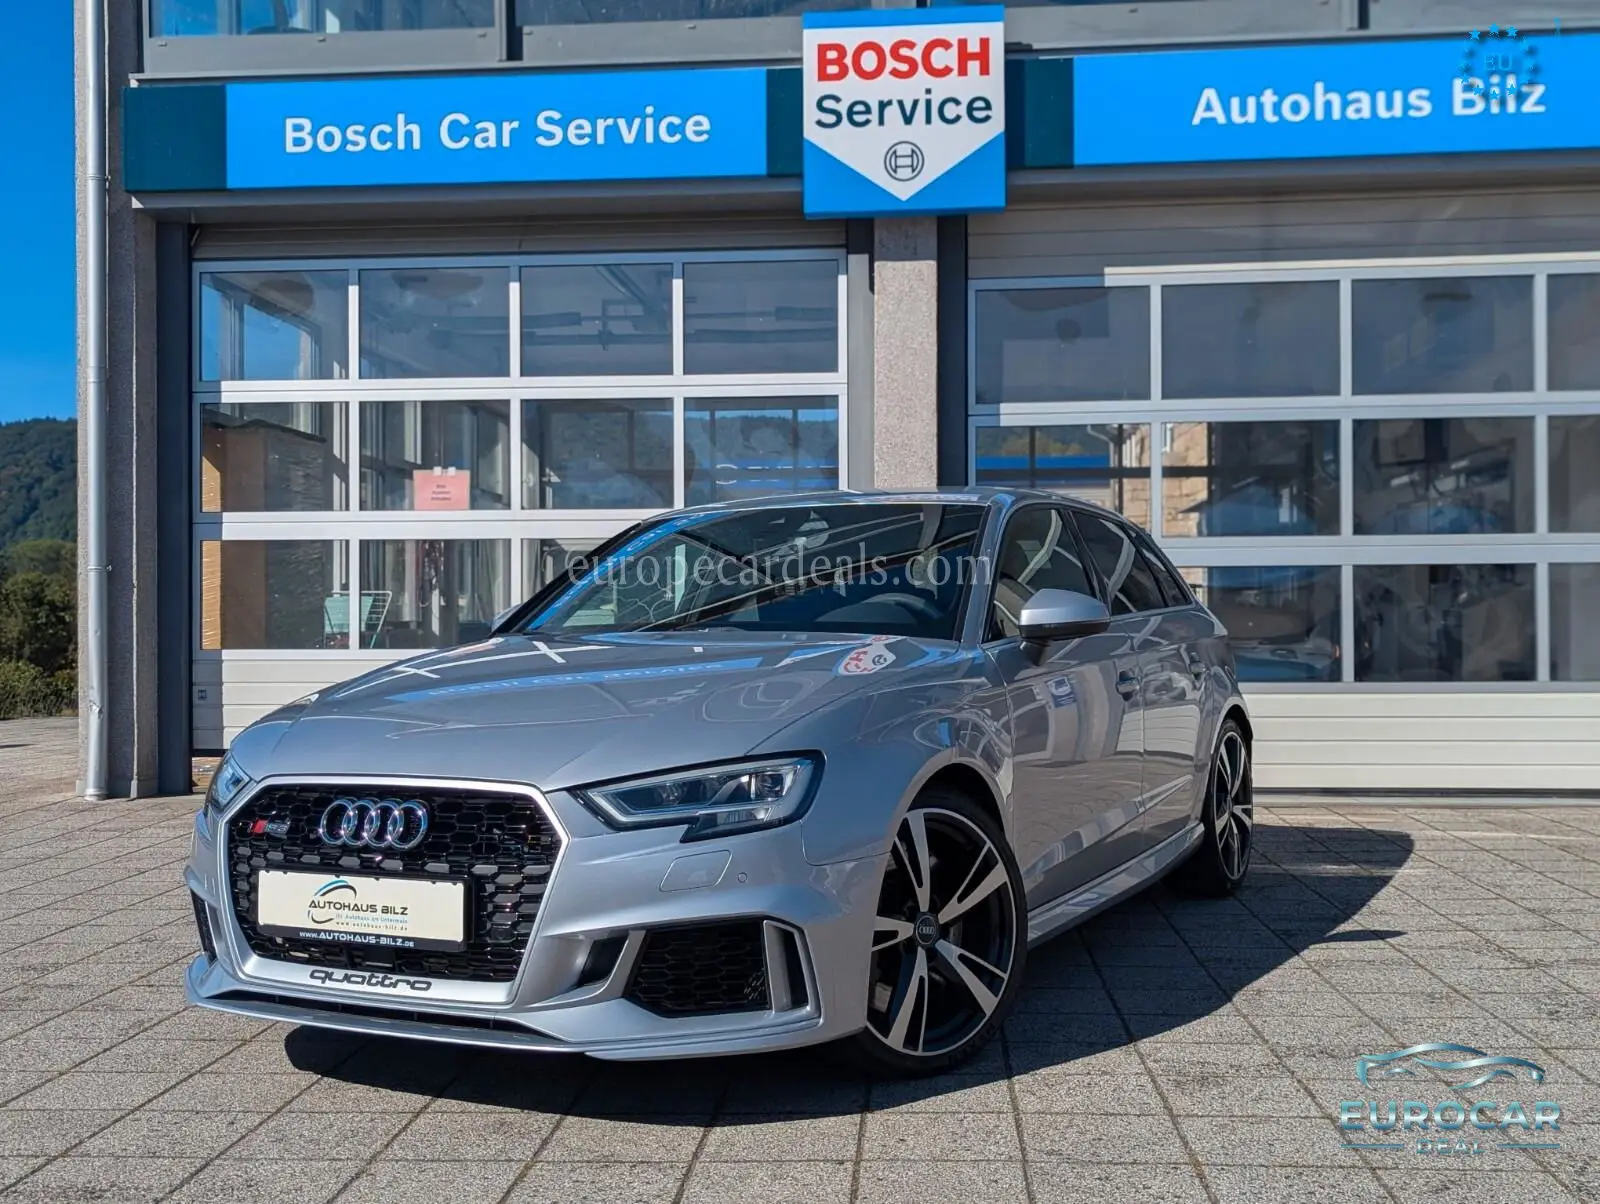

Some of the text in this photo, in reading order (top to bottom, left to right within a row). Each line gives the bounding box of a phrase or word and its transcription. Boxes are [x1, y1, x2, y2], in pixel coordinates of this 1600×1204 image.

[817, 37, 990, 82] BOSCH
[815, 88, 992, 129] Service
[1191, 73, 1547, 126] Autohaus Bilz
[284, 105, 711, 153] Bosch Car Service
[308, 899, 409, 915] AUTOHAUS BILZ
[309, 968, 432, 992] quattro
